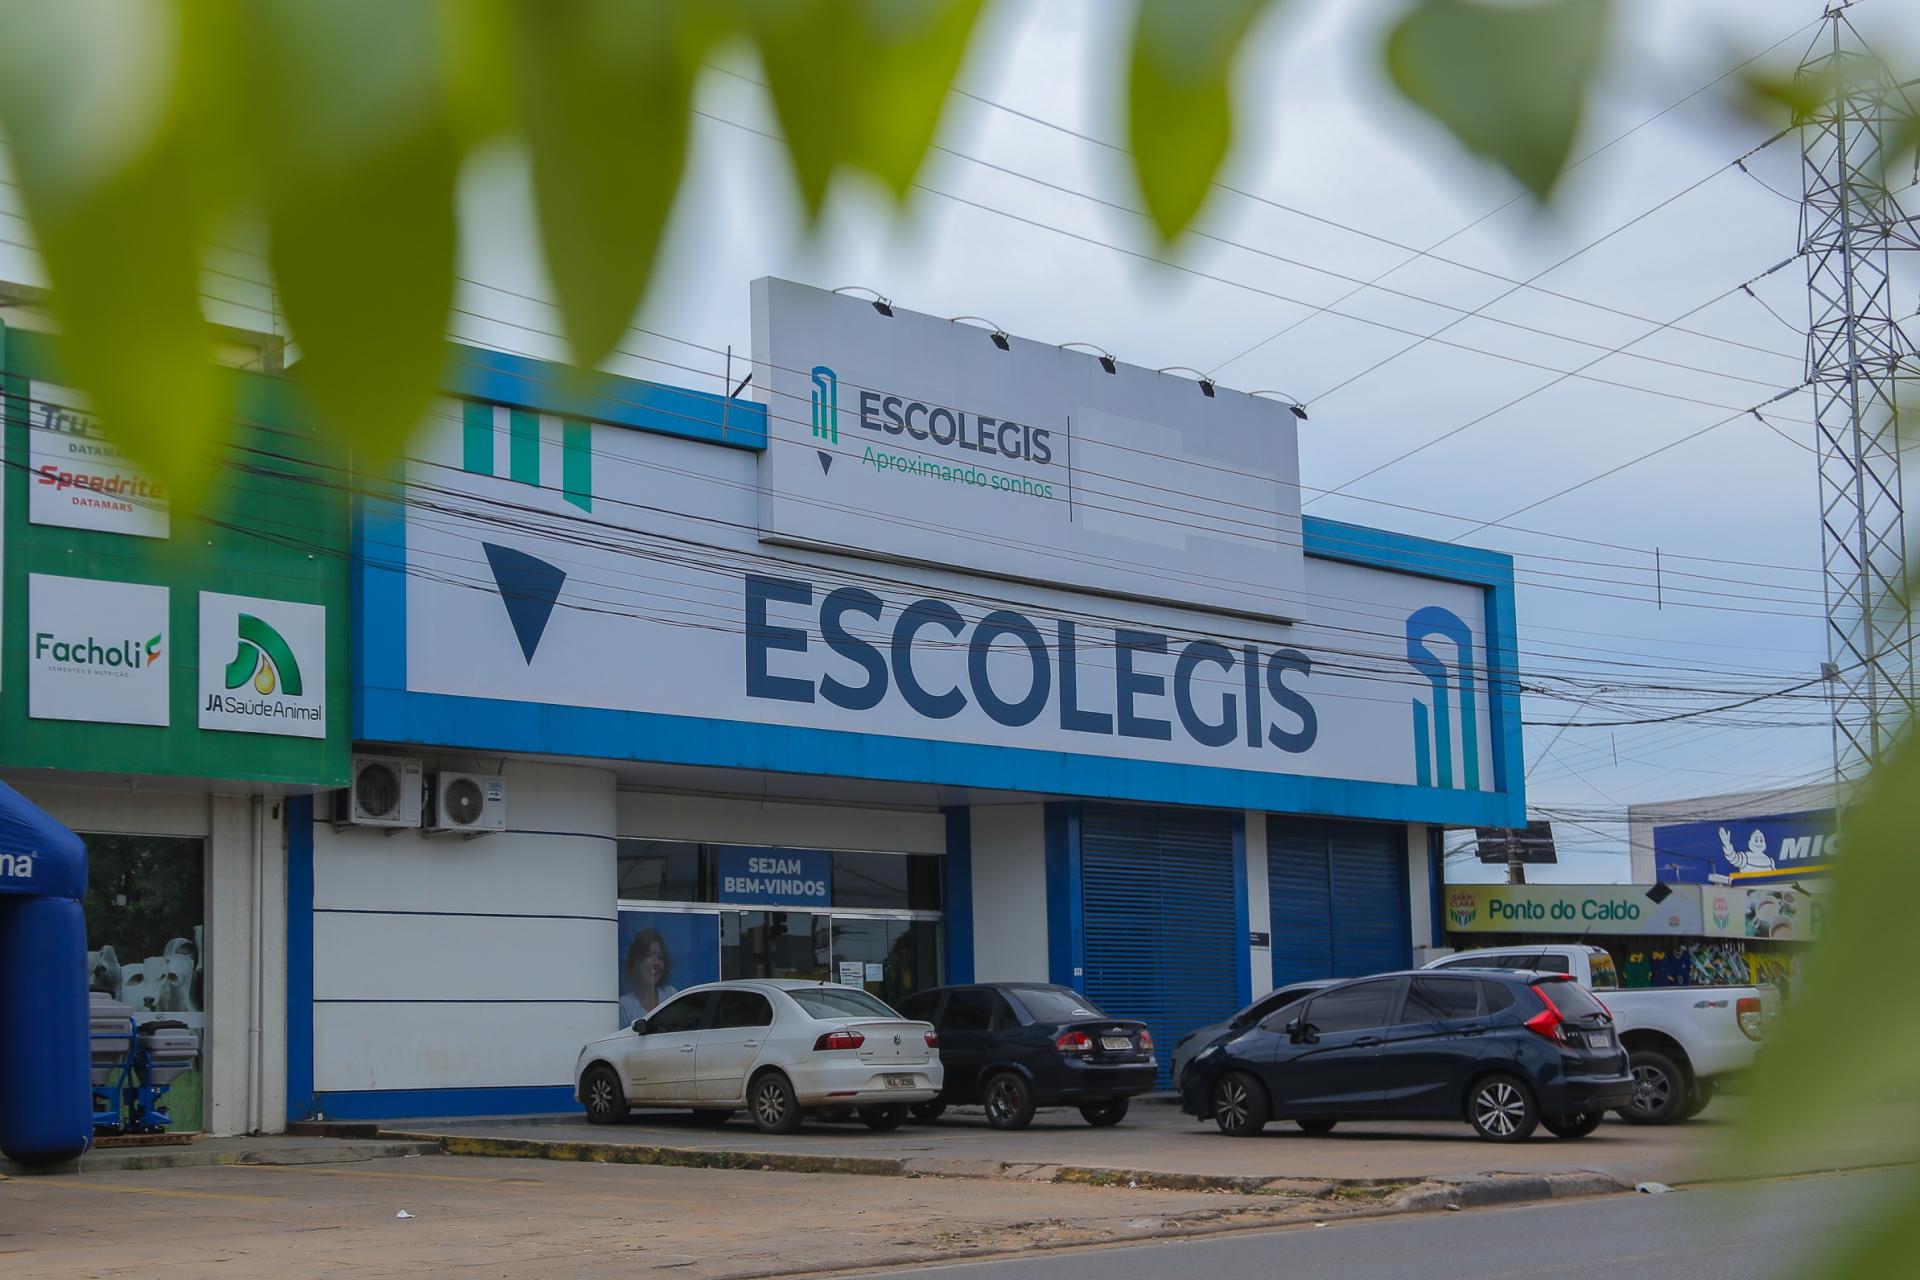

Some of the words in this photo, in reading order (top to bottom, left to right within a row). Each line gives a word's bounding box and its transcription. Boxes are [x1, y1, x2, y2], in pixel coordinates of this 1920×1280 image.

[859, 390, 1052, 465] ESCOLEGIS
[68, 443, 129, 460] DATAMA
[861, 446, 987, 488] Aproximando
[991, 473, 1054, 500] sonhos
[71, 496, 133, 512] DATAMARS
[36, 632, 141, 669] Facholi
[745, 574, 1319, 754] ESCOLEGIS
[748, 856, 801, 875] SEJAM
[724, 877, 826, 897] BEM-VINDOS
[1488, 899, 1545, 920] Ponto
[1550, 898, 1576, 920] do
[1581, 898, 1641, 921] Caldo
